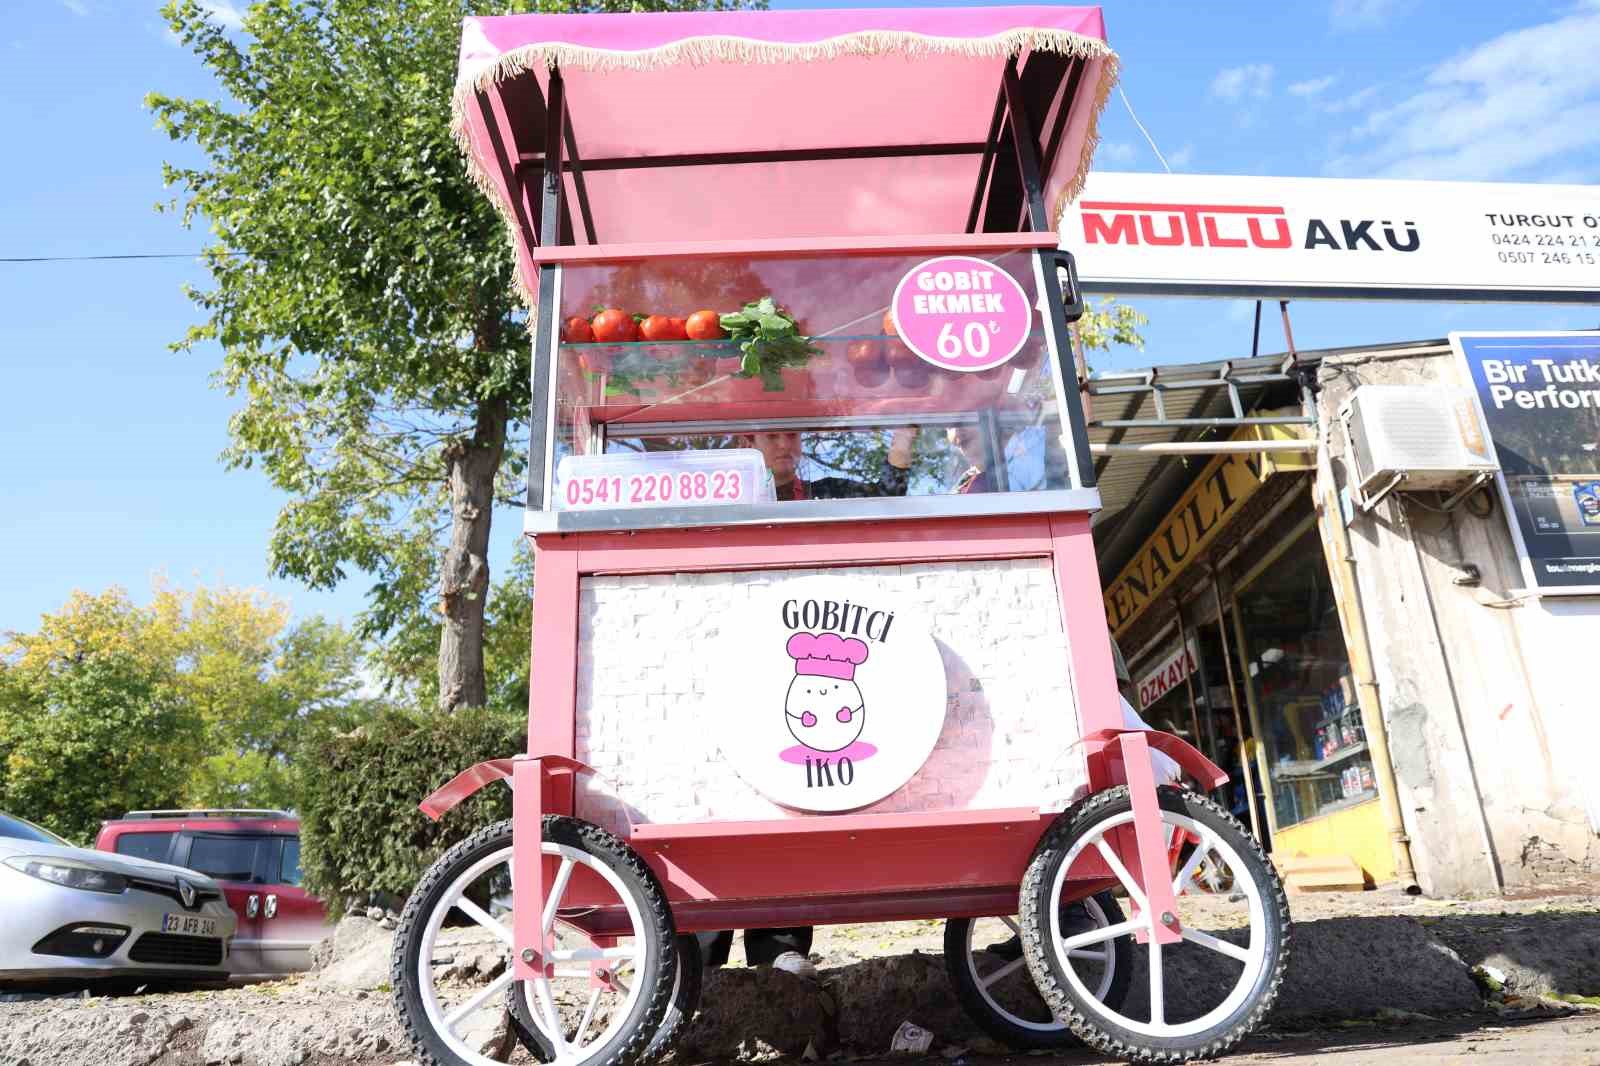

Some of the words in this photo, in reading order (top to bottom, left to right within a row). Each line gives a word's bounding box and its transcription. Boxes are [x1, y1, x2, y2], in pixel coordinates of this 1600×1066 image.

[1080, 201, 1293, 249] MUTLU
[1304, 218, 1420, 252] AKÜ
[1485, 213, 1574, 228] TURGUT
[1583, 212, 1600, 228] Ö
[1492, 233, 1531, 245] 0424
[1535, 234, 1564, 246] 224
[1568, 235, 1587, 247] 21
[1498, 251, 1535, 264] 0507
[912, 293, 1005, 314] EKMEK
[1482, 359, 1527, 384] Bir
[566, 477, 622, 505] 0541
[630, 475, 673, 503] 220
[679, 473, 707, 500] 88
[712, 472, 741, 499] 23
[1106, 452, 1237, 630] ENAULT
[167, 916, 179, 931] 23
